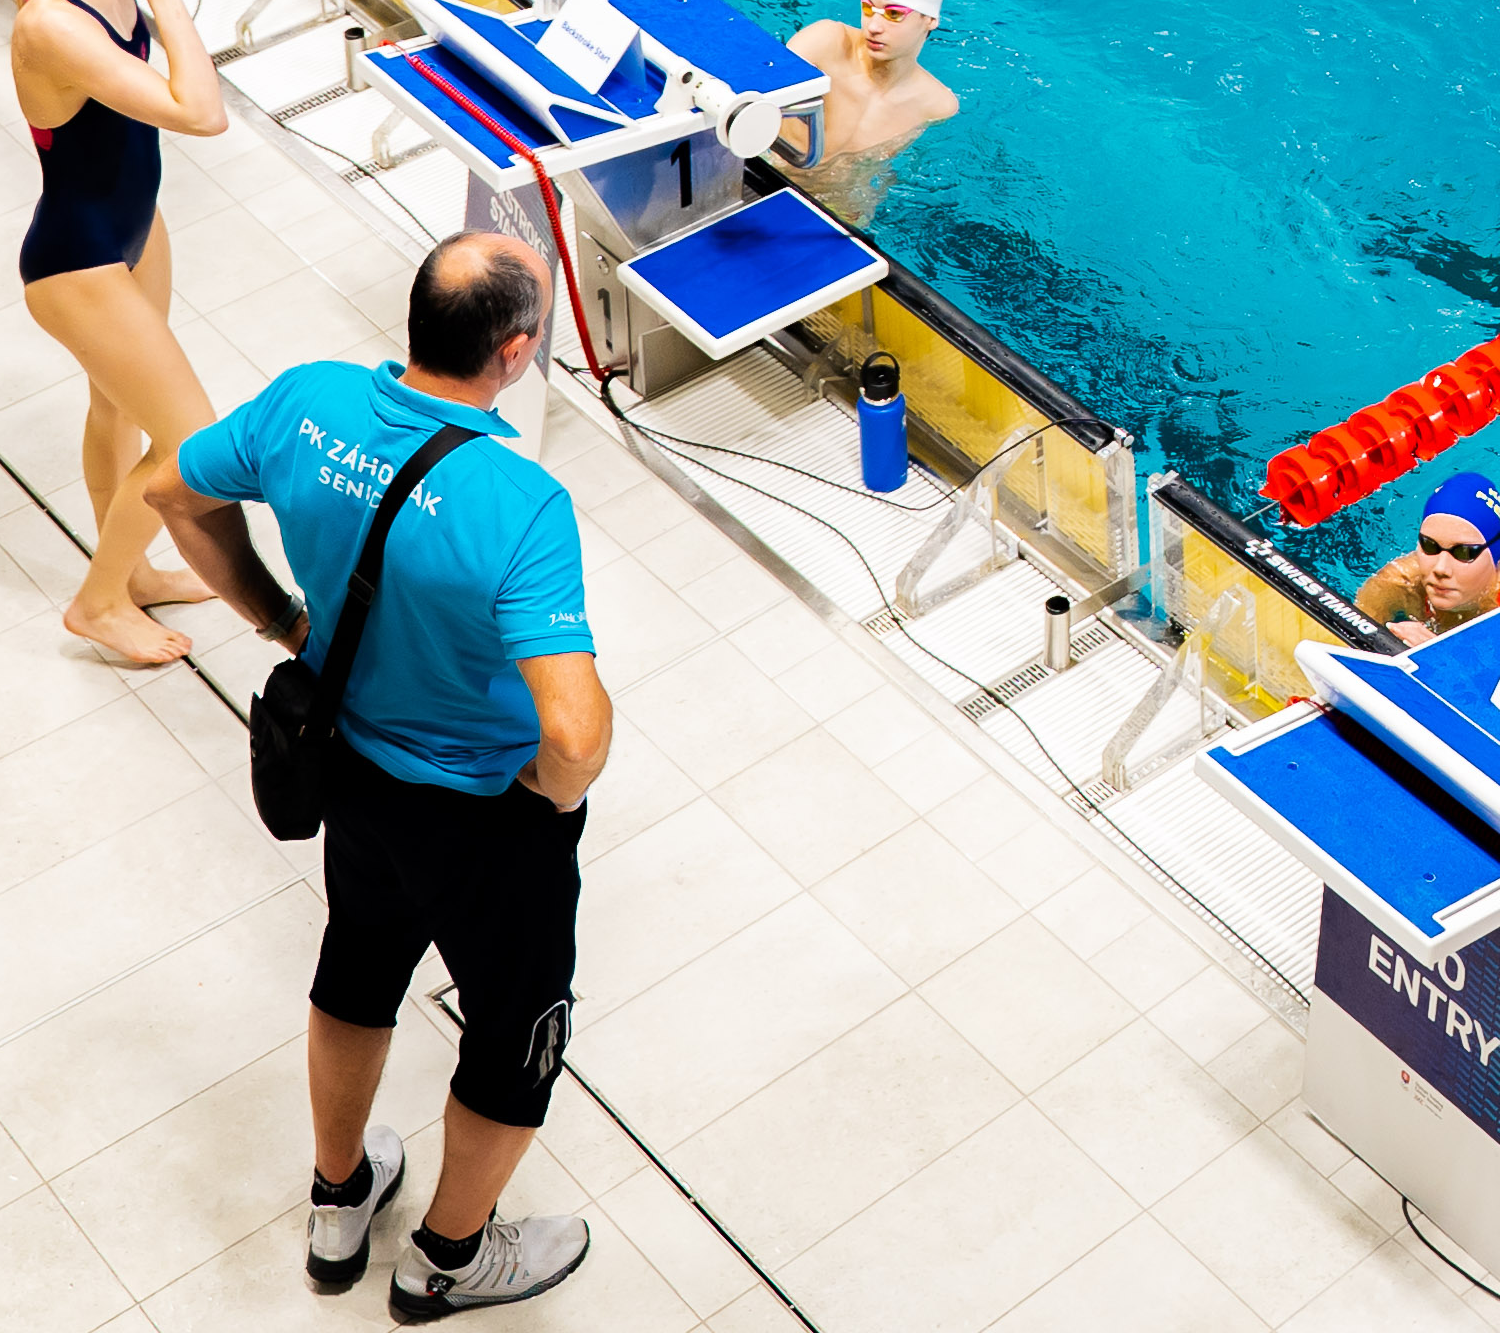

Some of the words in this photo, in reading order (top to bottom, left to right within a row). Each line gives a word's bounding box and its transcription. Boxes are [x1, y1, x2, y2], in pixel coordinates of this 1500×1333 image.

[561, 20, 595, 54] Backstroke
[593, 47, 611, 64] Start
[670, 139, 693, 209] 1
[502, 189, 549, 263] STROKE
[299, 418, 327, 450] PK
[326, 438, 443, 517] ZÁHOÁK
[1265, 553, 1323, 597] SWISS
[1318, 588, 1378, 635] TIMING
